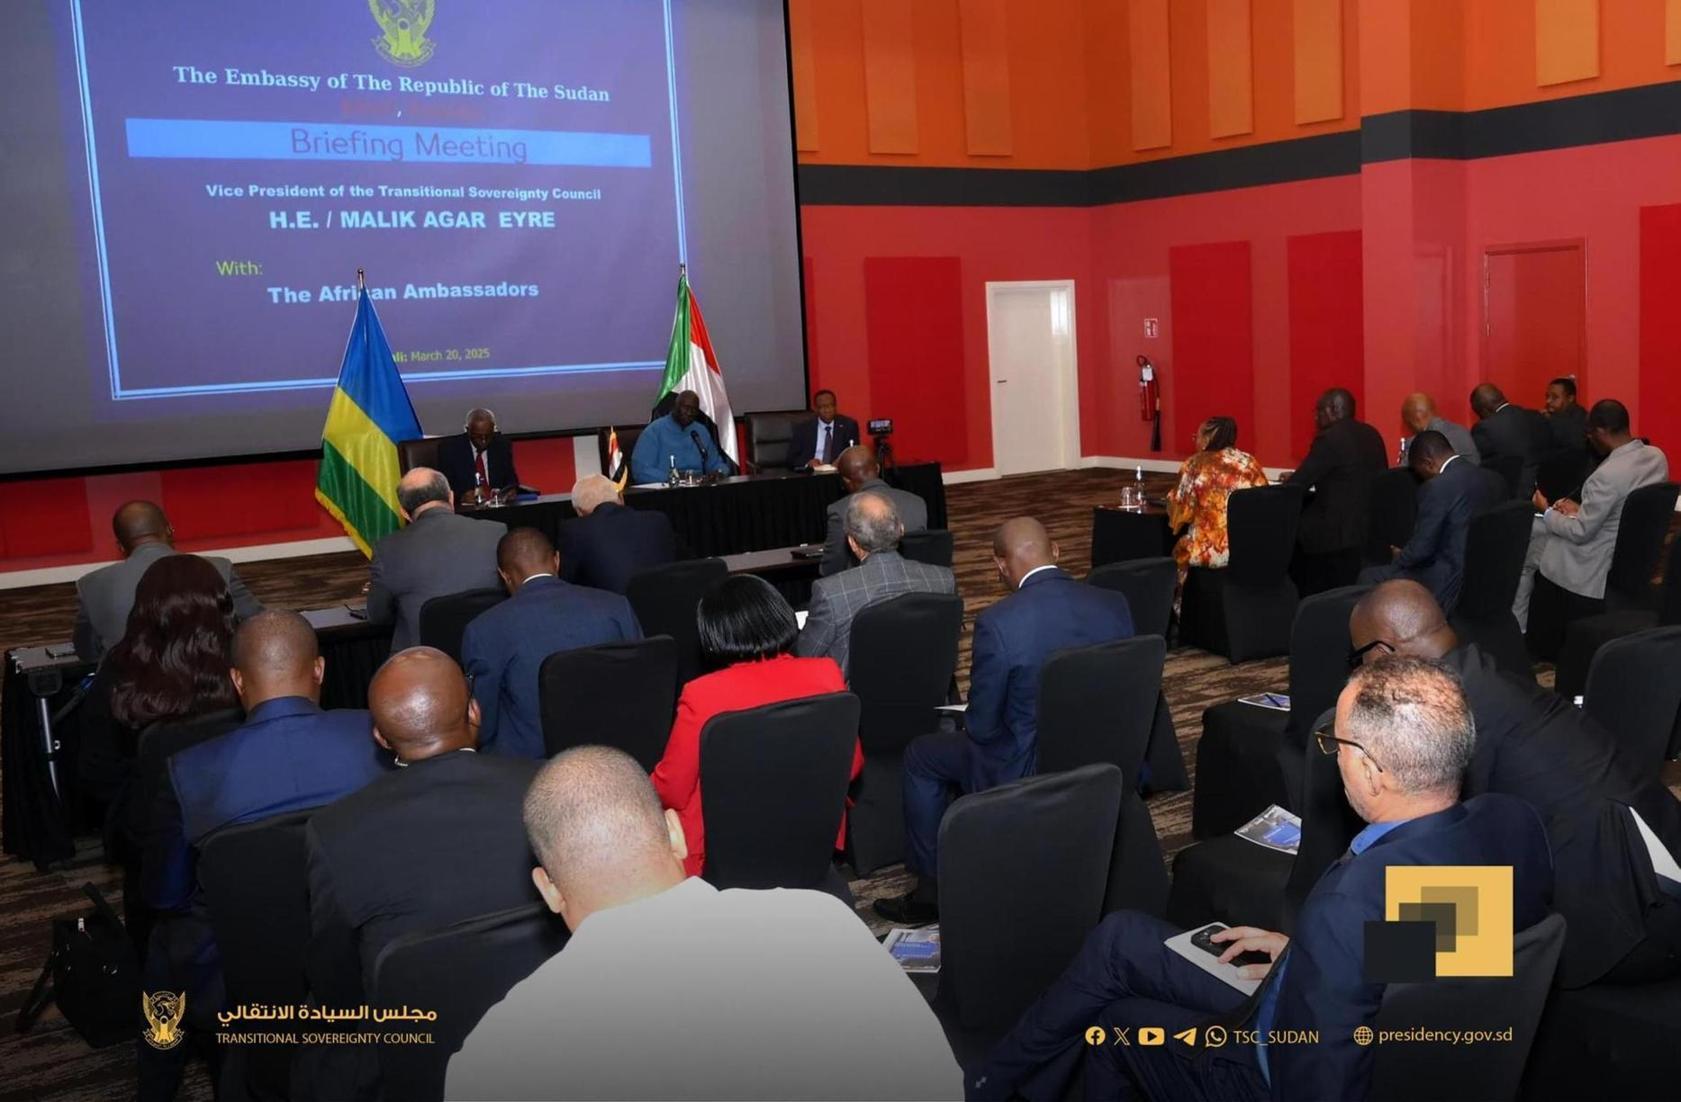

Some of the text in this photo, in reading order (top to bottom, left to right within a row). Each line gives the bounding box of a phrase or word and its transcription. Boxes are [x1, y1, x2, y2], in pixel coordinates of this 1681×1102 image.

[173, 66, 610, 101] The Embassy of The Republic of The Sudan
[291, 127, 527, 163] Briefing Meeting
[206, 185, 601, 201] Vice President of the Transitional Sovereignty Council
[269, 211, 319, 228] H.E.
[340, 211, 416, 228] MALIK
[423, 211, 486, 228] AGAR
[499, 211, 555, 228] EYRE
[216, 261, 263, 276] With:
[267, 282, 539, 304] The Afrian Ambassadors
[411, 350, 442, 361] March
[446, 349, 462, 361] 20,
[465, 347, 490, 360] 2025
